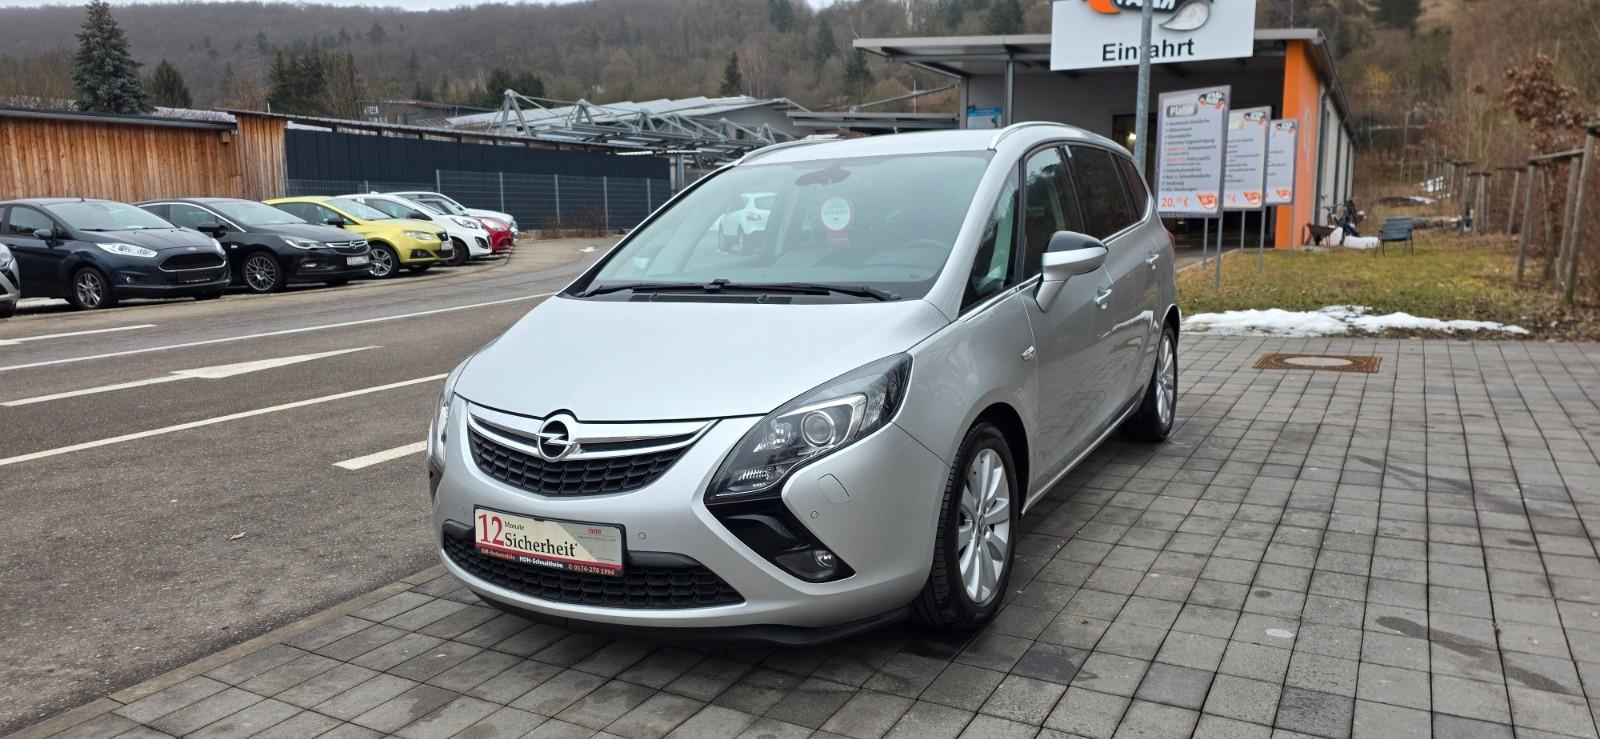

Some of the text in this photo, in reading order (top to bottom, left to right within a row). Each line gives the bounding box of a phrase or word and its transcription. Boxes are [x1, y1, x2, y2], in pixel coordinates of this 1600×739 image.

[1102, 38, 1195, 62] Einahrt
[478, 512, 505, 546] 12
[504, 520, 525, 531] Monate
